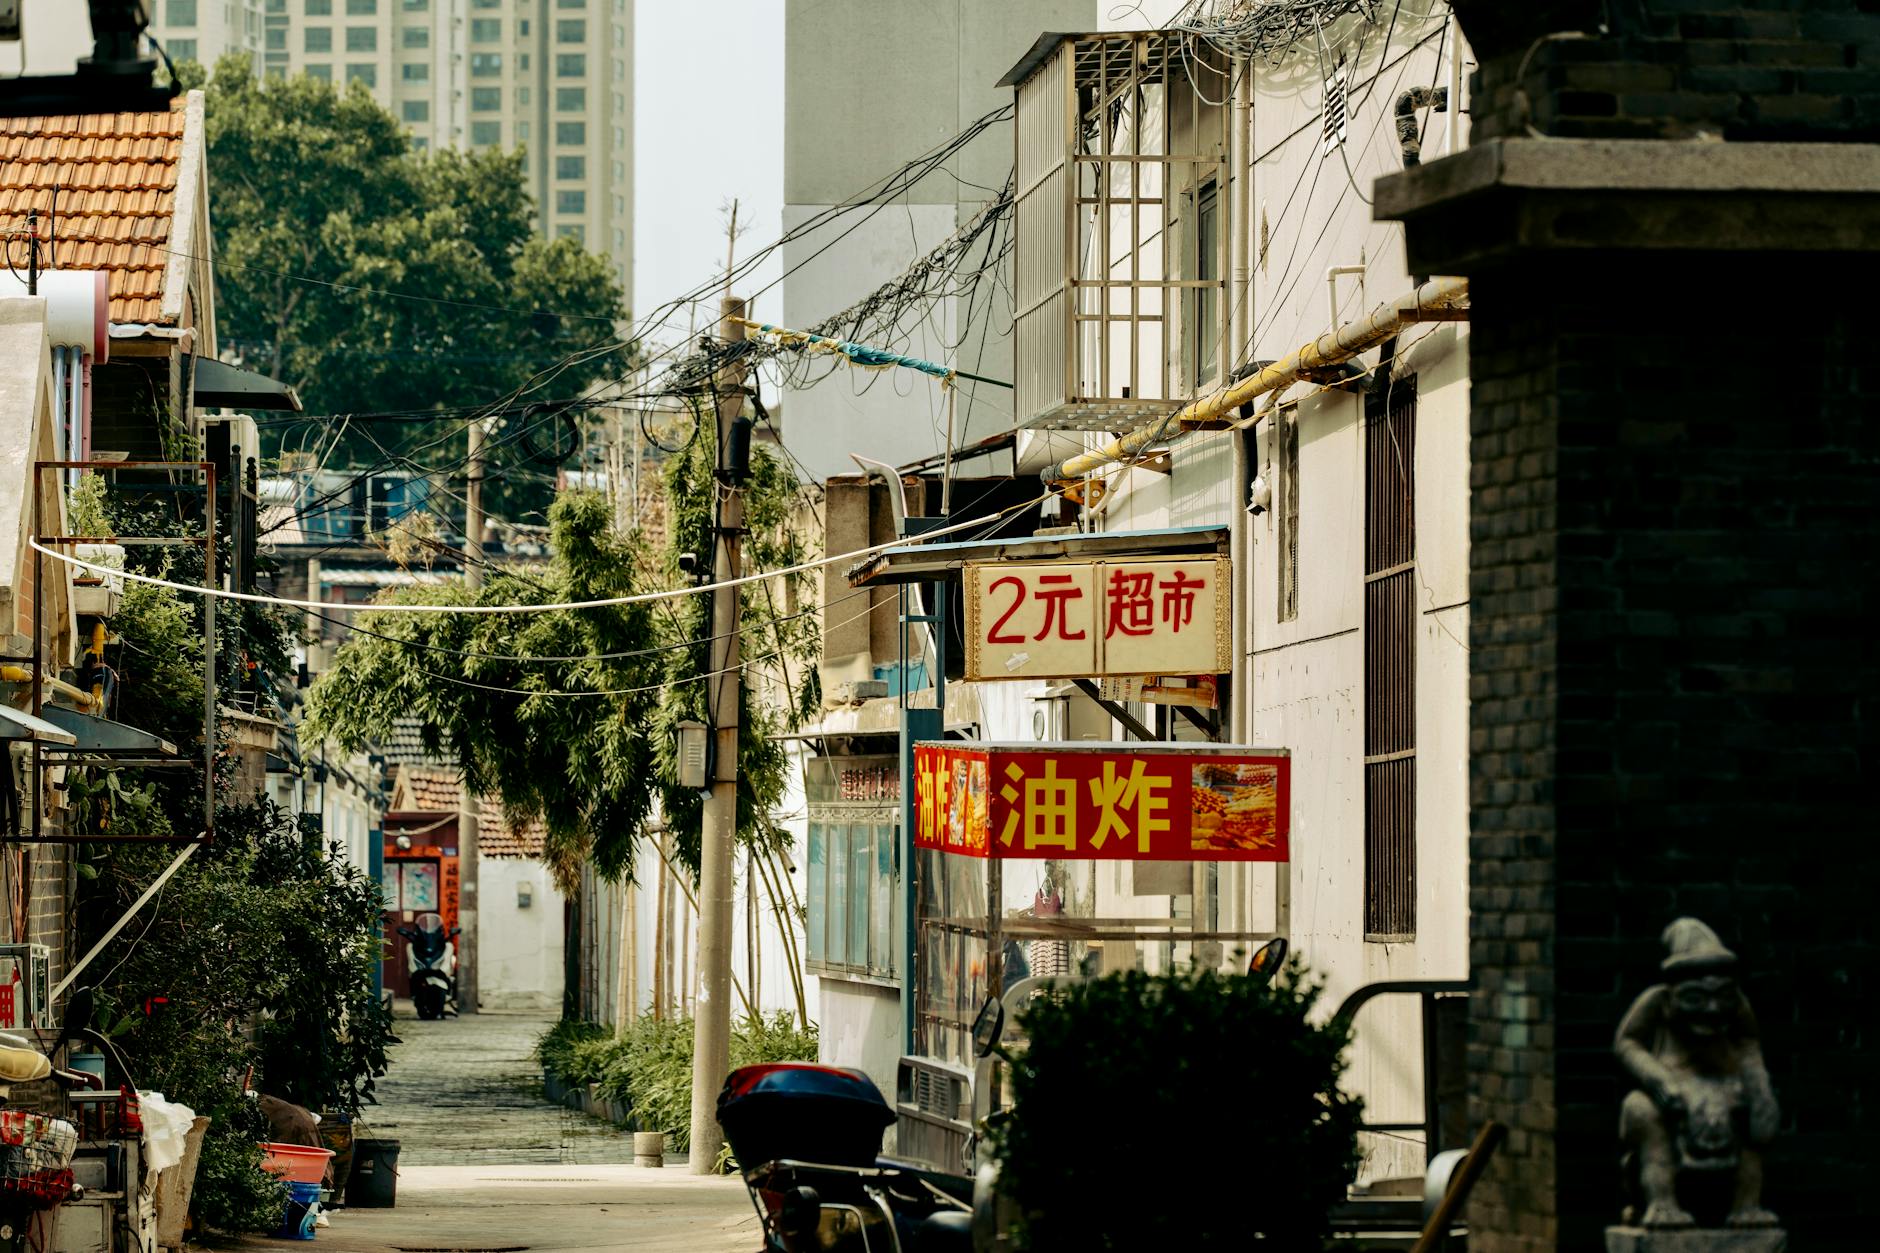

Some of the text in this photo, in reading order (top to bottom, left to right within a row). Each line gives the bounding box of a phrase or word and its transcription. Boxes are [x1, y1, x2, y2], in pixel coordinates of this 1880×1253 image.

[987, 569, 1205, 644] 2元超市
[918, 754, 950, 845] 油炸
[1000, 759, 1172, 852] 油炸
